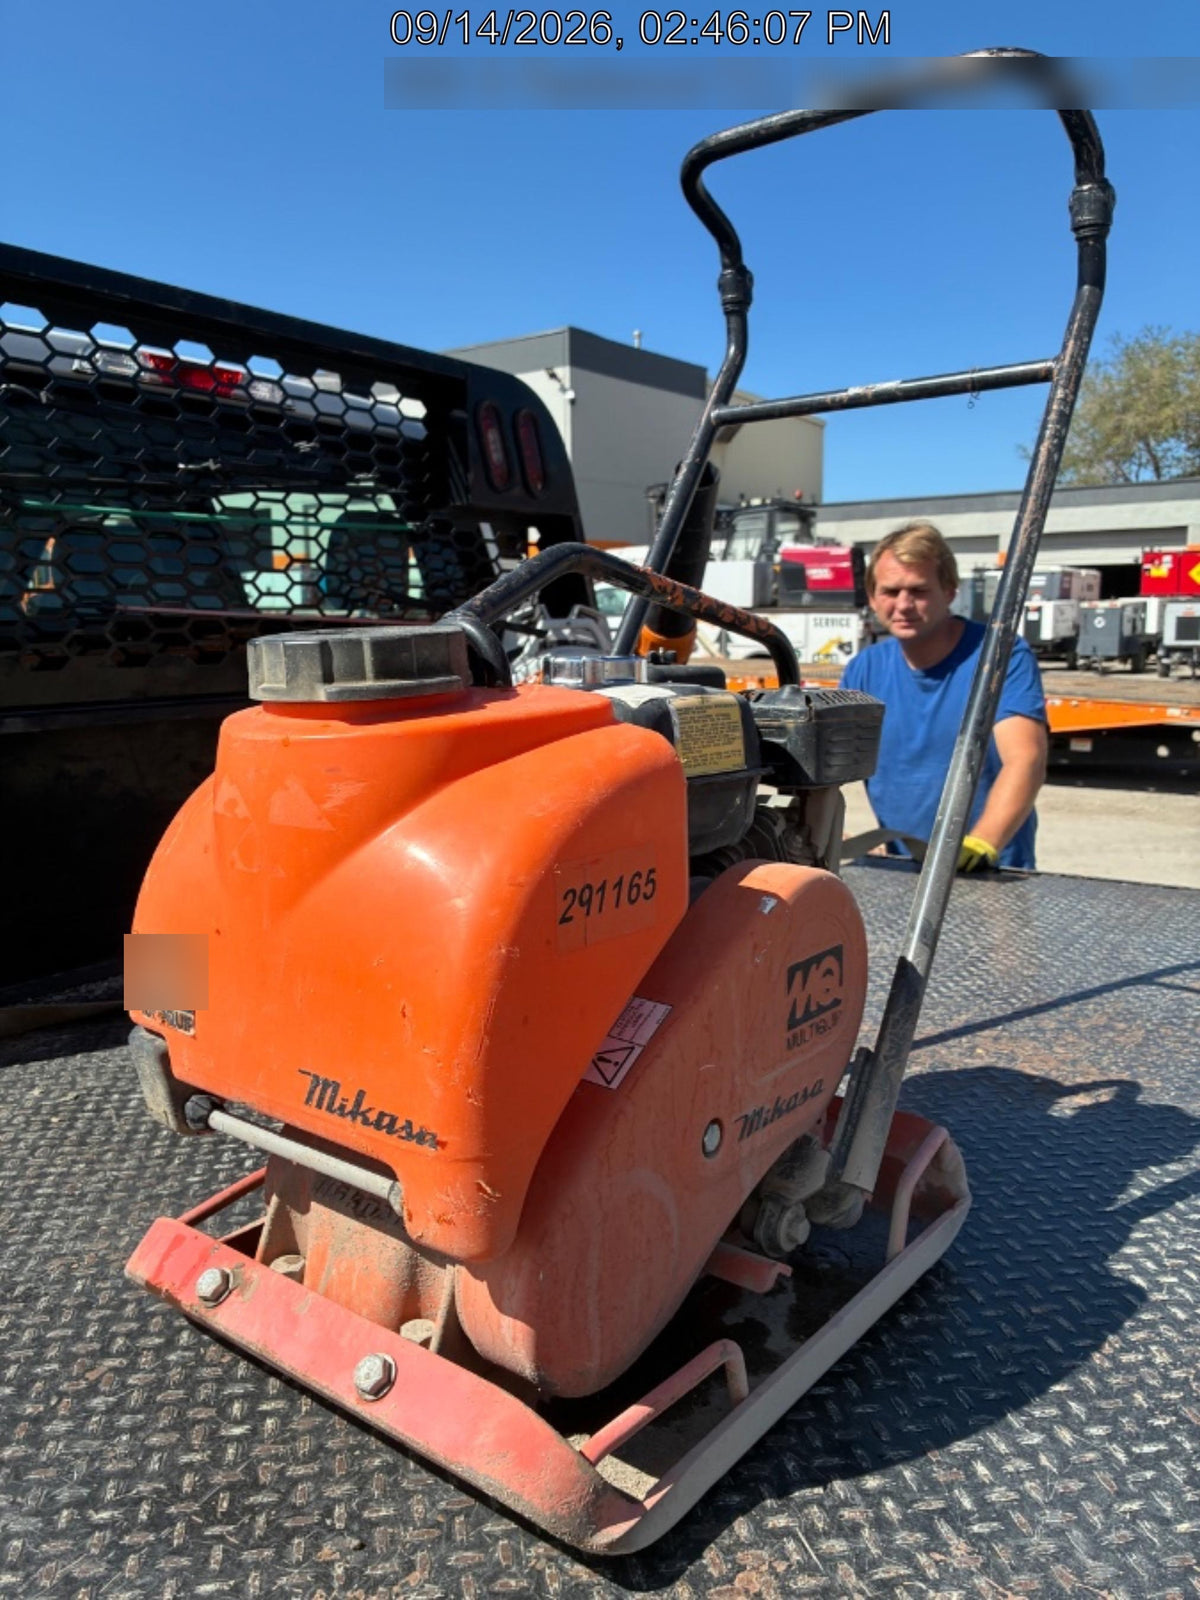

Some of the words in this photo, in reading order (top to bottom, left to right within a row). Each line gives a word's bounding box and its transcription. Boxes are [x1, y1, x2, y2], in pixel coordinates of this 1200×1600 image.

[813, 616, 851, 628] SERVICE
[558, 867, 657, 925] 291165
[298, 1069, 443, 1150] Mikasa
[734, 1078, 824, 1141] Mikasa
